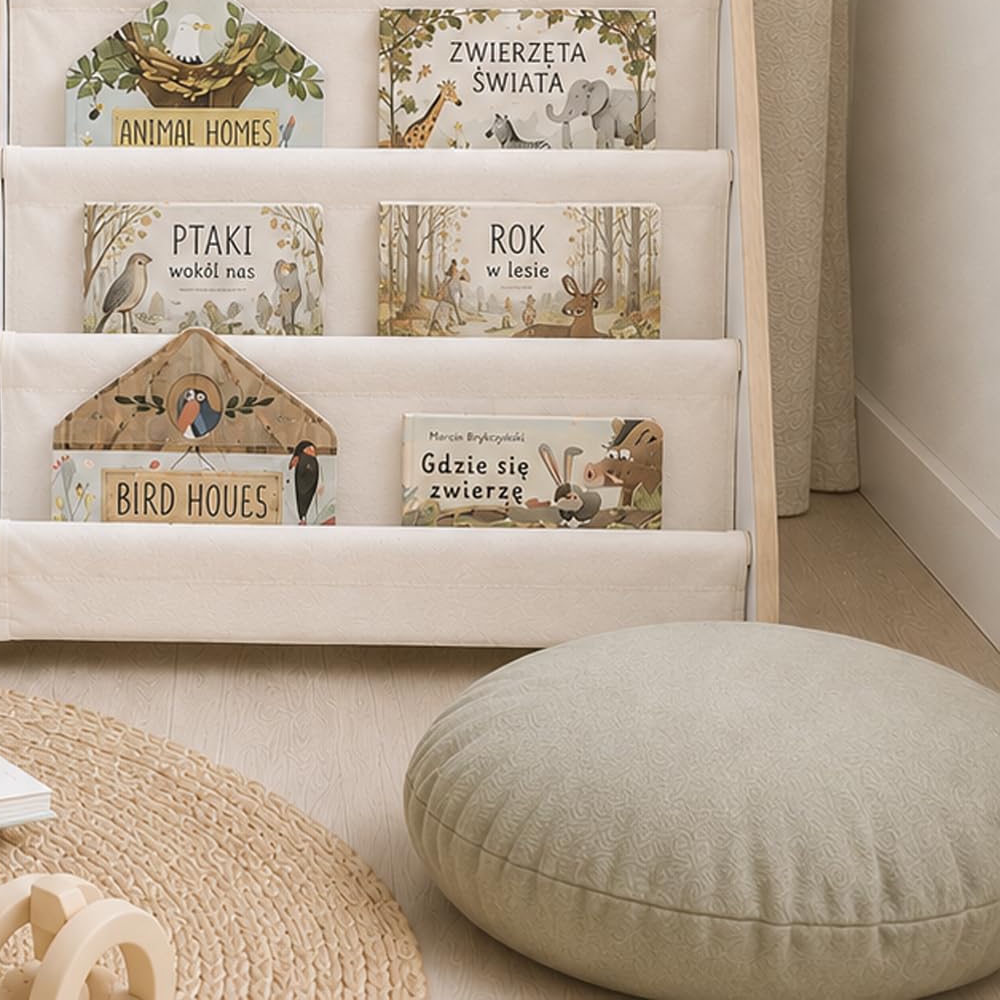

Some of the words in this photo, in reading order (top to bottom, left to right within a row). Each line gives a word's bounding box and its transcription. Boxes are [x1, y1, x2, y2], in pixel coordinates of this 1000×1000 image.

[120, 119, 195, 146] ANIMAL
[206, 119, 273, 146] HOMES
[173, 225, 252, 255] PTAKI
[490, 224, 546, 254] ROK
[226, 265, 255, 279] nas
[486, 265, 500, 277] w
[508, 262, 549, 279] lesie
[421, 453, 487, 474] Gdzie
[497, 455, 529, 480] się
[117, 482, 175, 516] BIRD
[187, 484, 267, 518] HOUES
